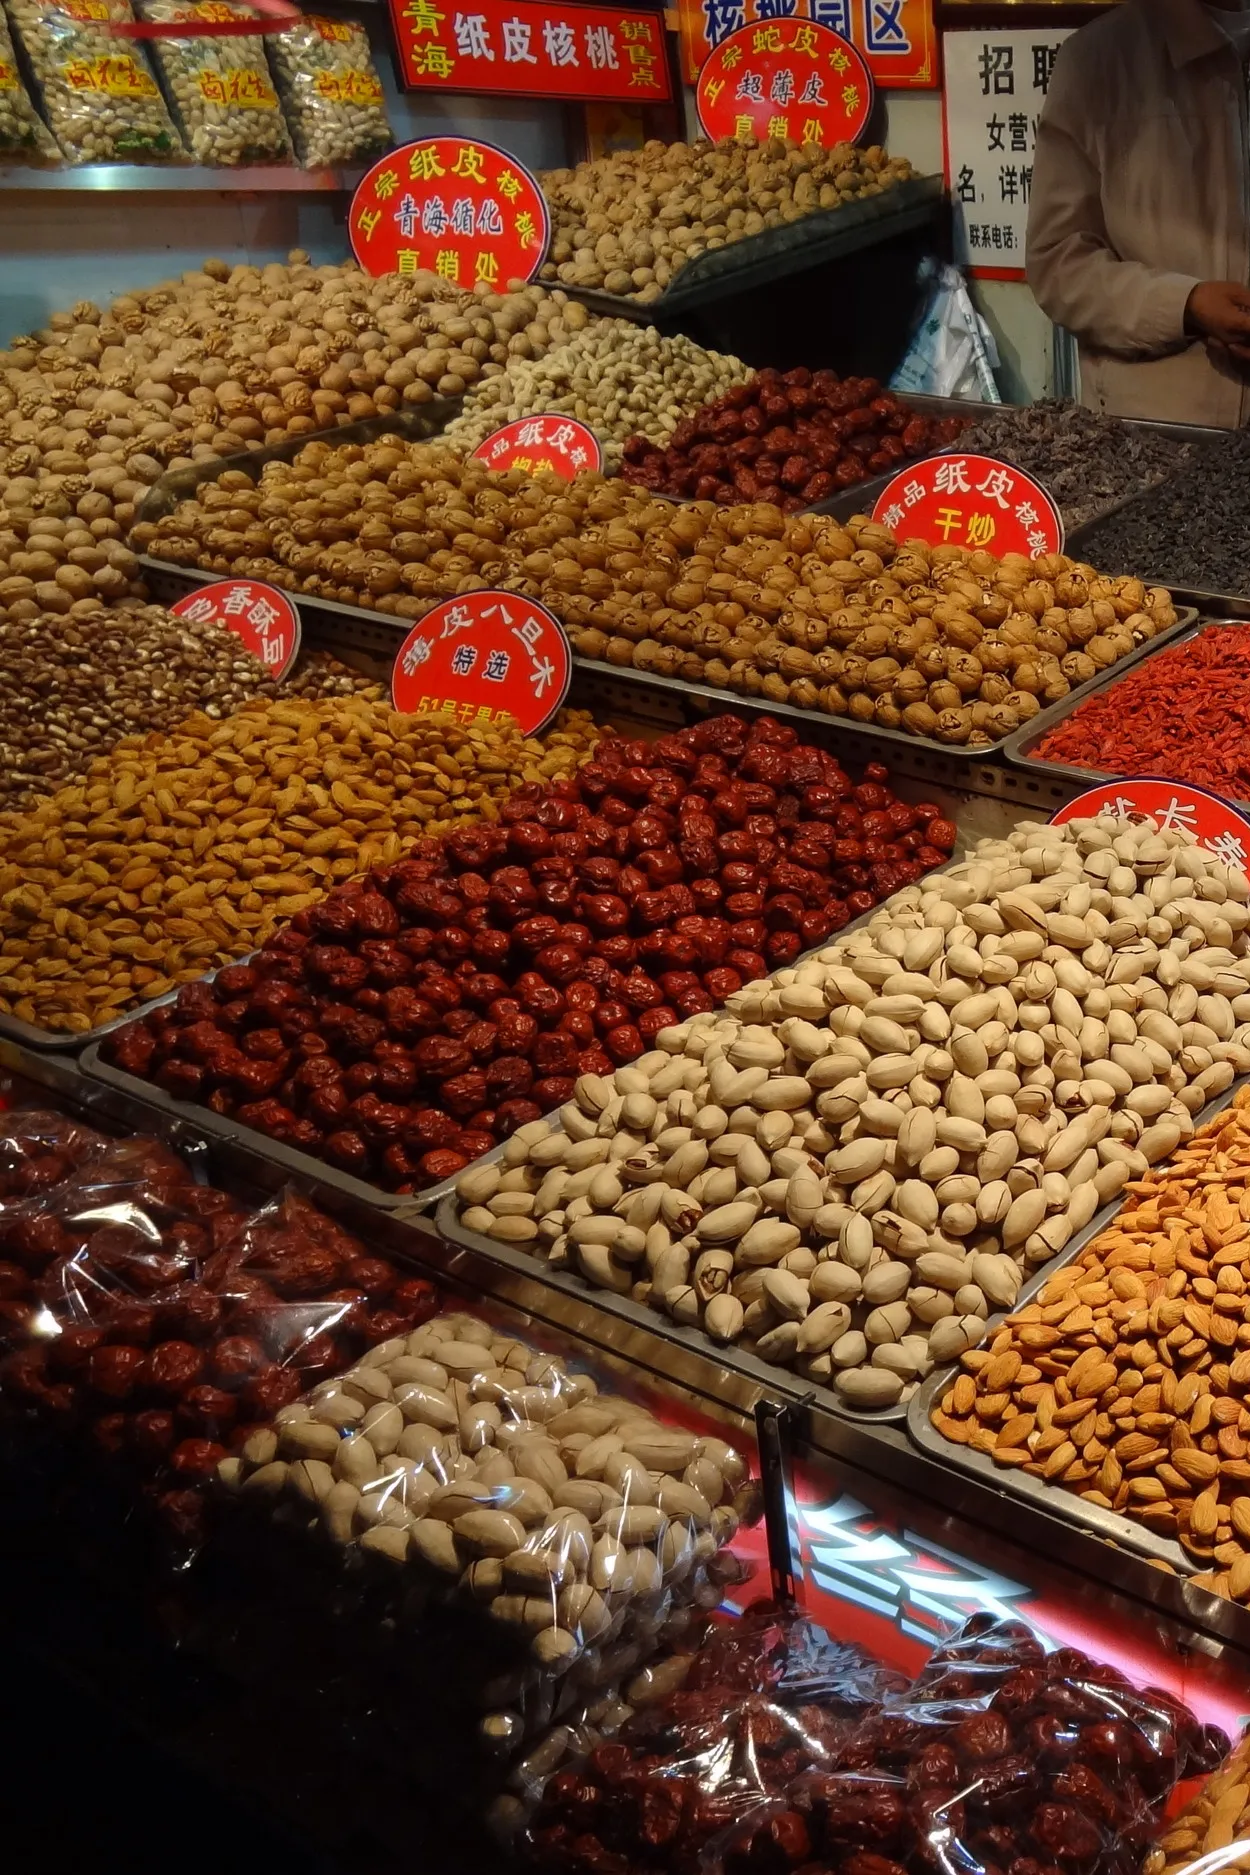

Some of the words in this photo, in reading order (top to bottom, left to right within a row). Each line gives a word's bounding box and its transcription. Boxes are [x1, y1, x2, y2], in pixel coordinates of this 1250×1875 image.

[402, 0, 455, 79] 青海
[453, 11, 620, 70] 纸皮核桃
[618, 19, 661, 89] 销售点
[736, 68, 828, 108] 超薄皮
[734, 113, 825, 146] 直销处
[357, 144, 537, 249] 正宗纸皮核桃
[394, 193, 503, 239] 青海循化
[396, 248, 499, 283] 直销处
[934, 507, 996, 546] 干炒
[451, 644, 511, 683] 特选
